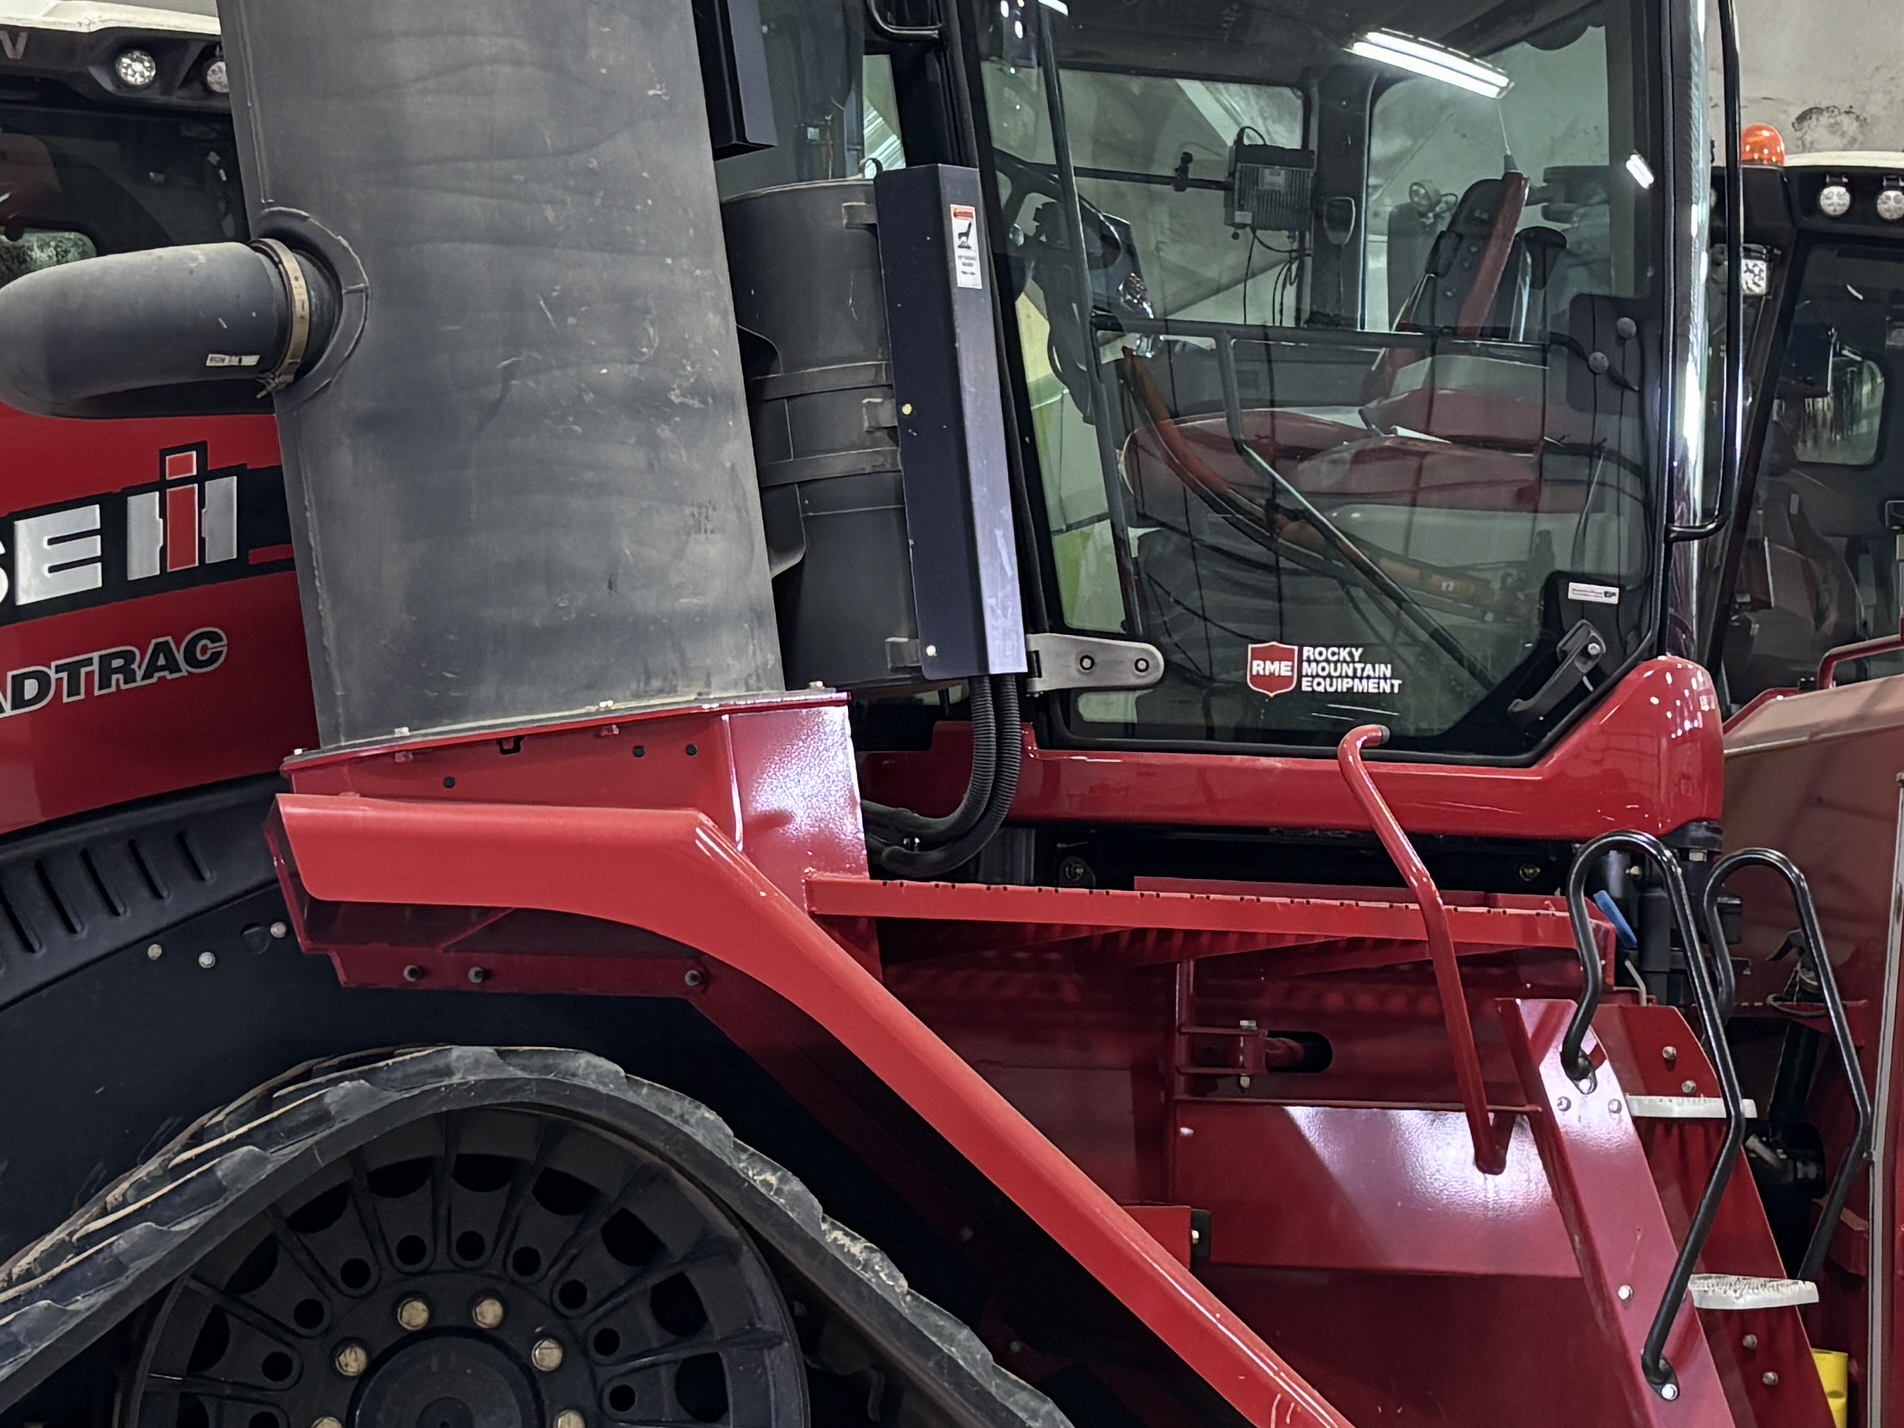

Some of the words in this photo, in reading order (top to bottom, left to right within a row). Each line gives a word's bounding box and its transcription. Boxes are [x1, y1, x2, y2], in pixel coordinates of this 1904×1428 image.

[1302, 646, 1364, 662] ROCKY
[1252, 660, 1292, 676] RME
[1302, 662, 1392, 678] MOUNTAIN
[1301, 677, 1402, 693] EQUIPMENT
